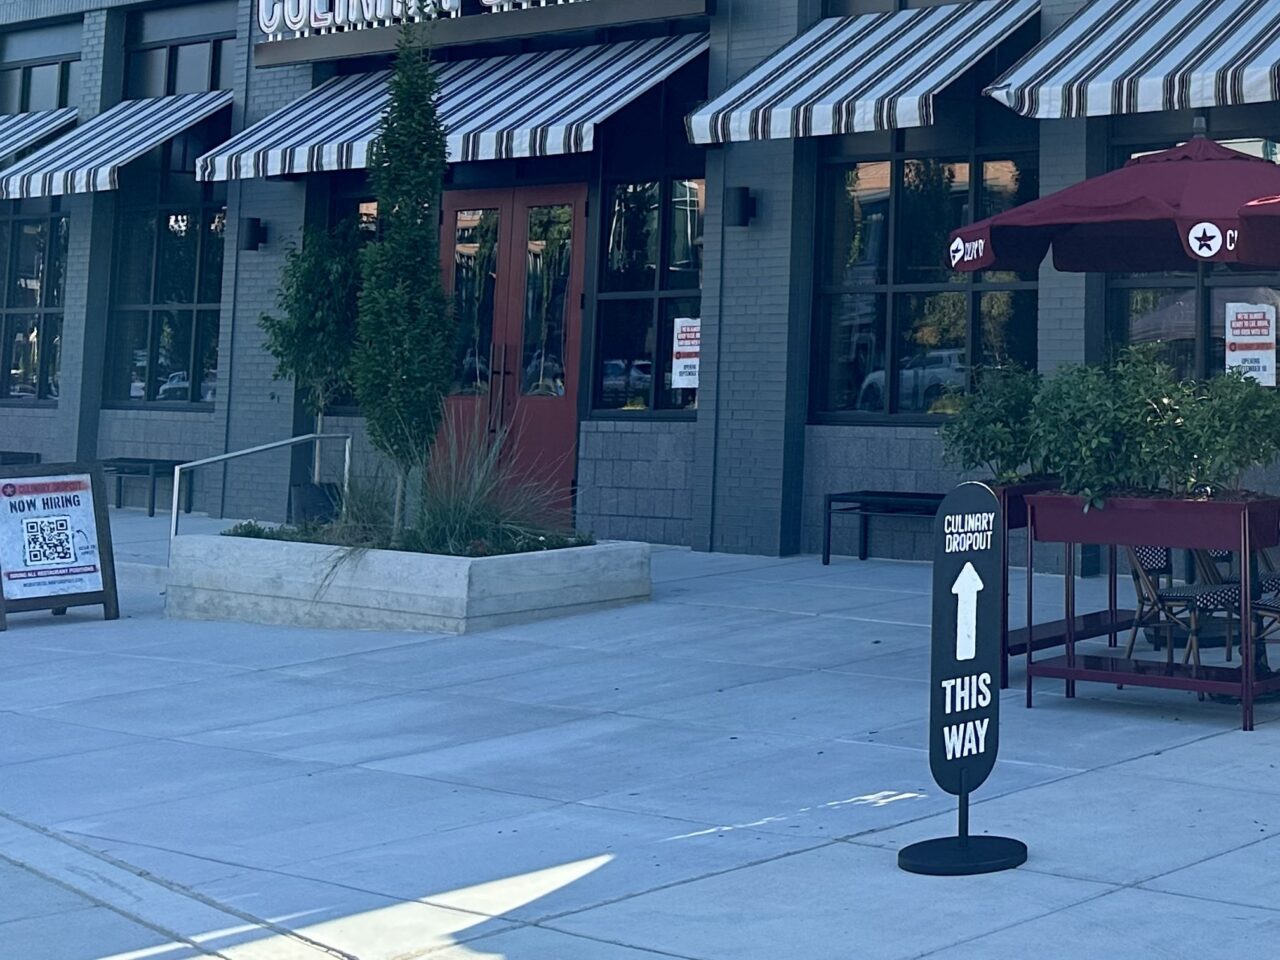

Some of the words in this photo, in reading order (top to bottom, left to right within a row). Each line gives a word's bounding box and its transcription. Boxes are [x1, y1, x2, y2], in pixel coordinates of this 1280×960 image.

[9, 498, 37, 513] NOW
[41, 494, 81, 511] HIRING
[944, 512, 995, 534] CULINARY
[945, 531, 993, 553] DROPOUT
[941, 672, 992, 714] THIS
[943, 718, 990, 761] WAY
